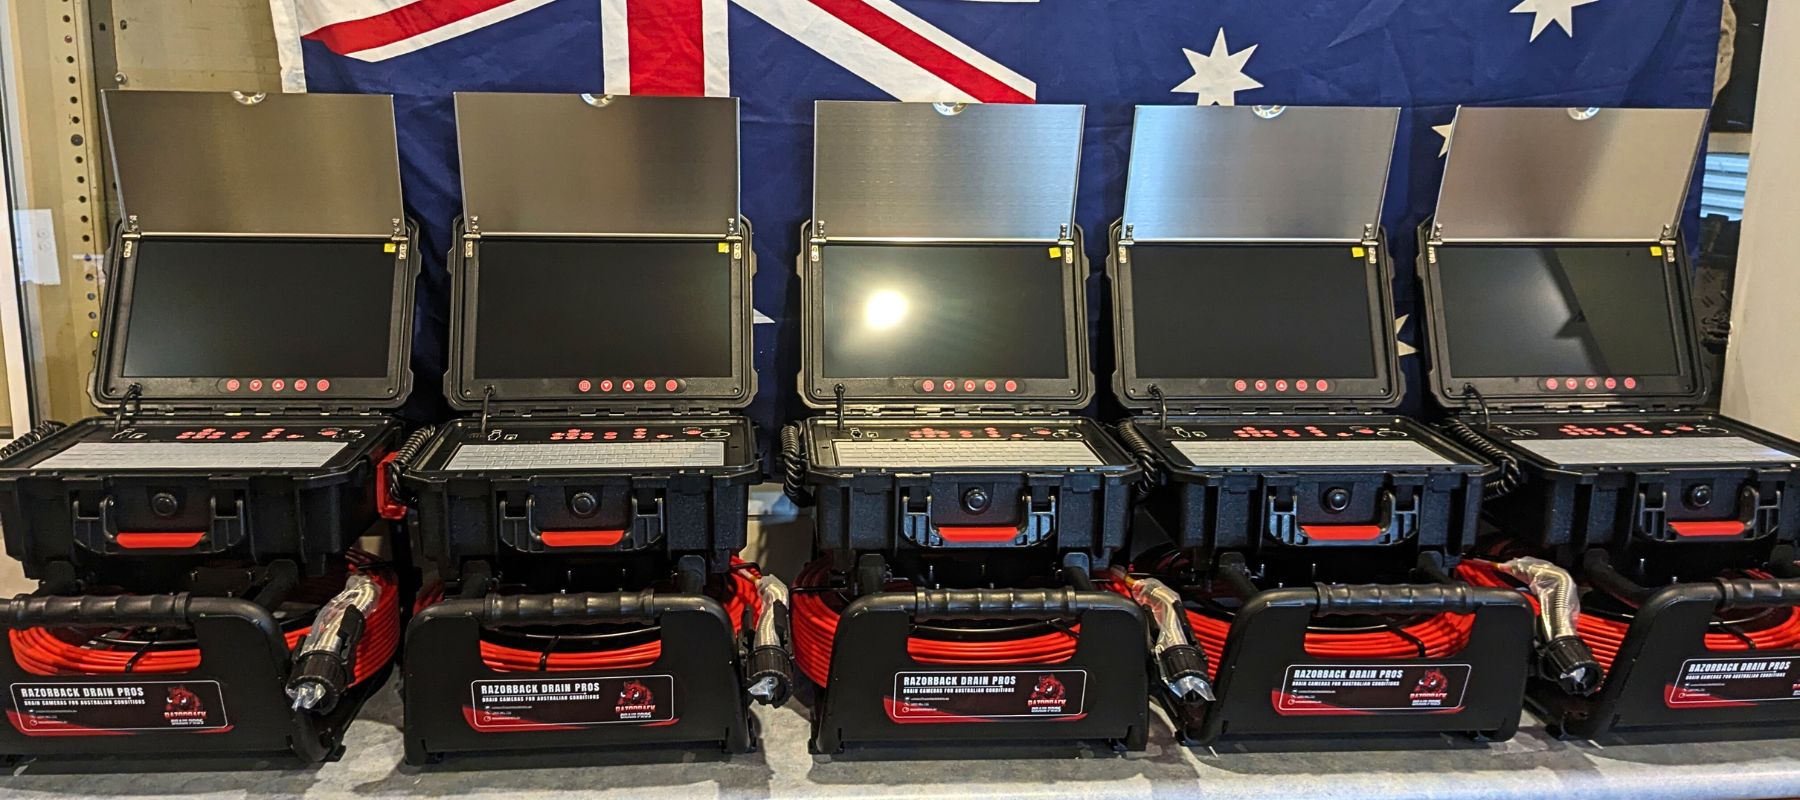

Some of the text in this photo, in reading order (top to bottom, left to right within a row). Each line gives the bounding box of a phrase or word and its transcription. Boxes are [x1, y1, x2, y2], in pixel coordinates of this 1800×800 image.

[1689, 662, 1791, 672] RAZORBACK DRAIN PROS
[1294, 670, 1404, 678] RAZORBACK DRAIN PROS
[903, 676, 1016, 686] RAZORBACK DRAIN PROS
[21, 687, 144, 697] RAZORBACK DRAIN PROS
[481, 683, 600, 694] RAZORBACK DRAIN PROS
